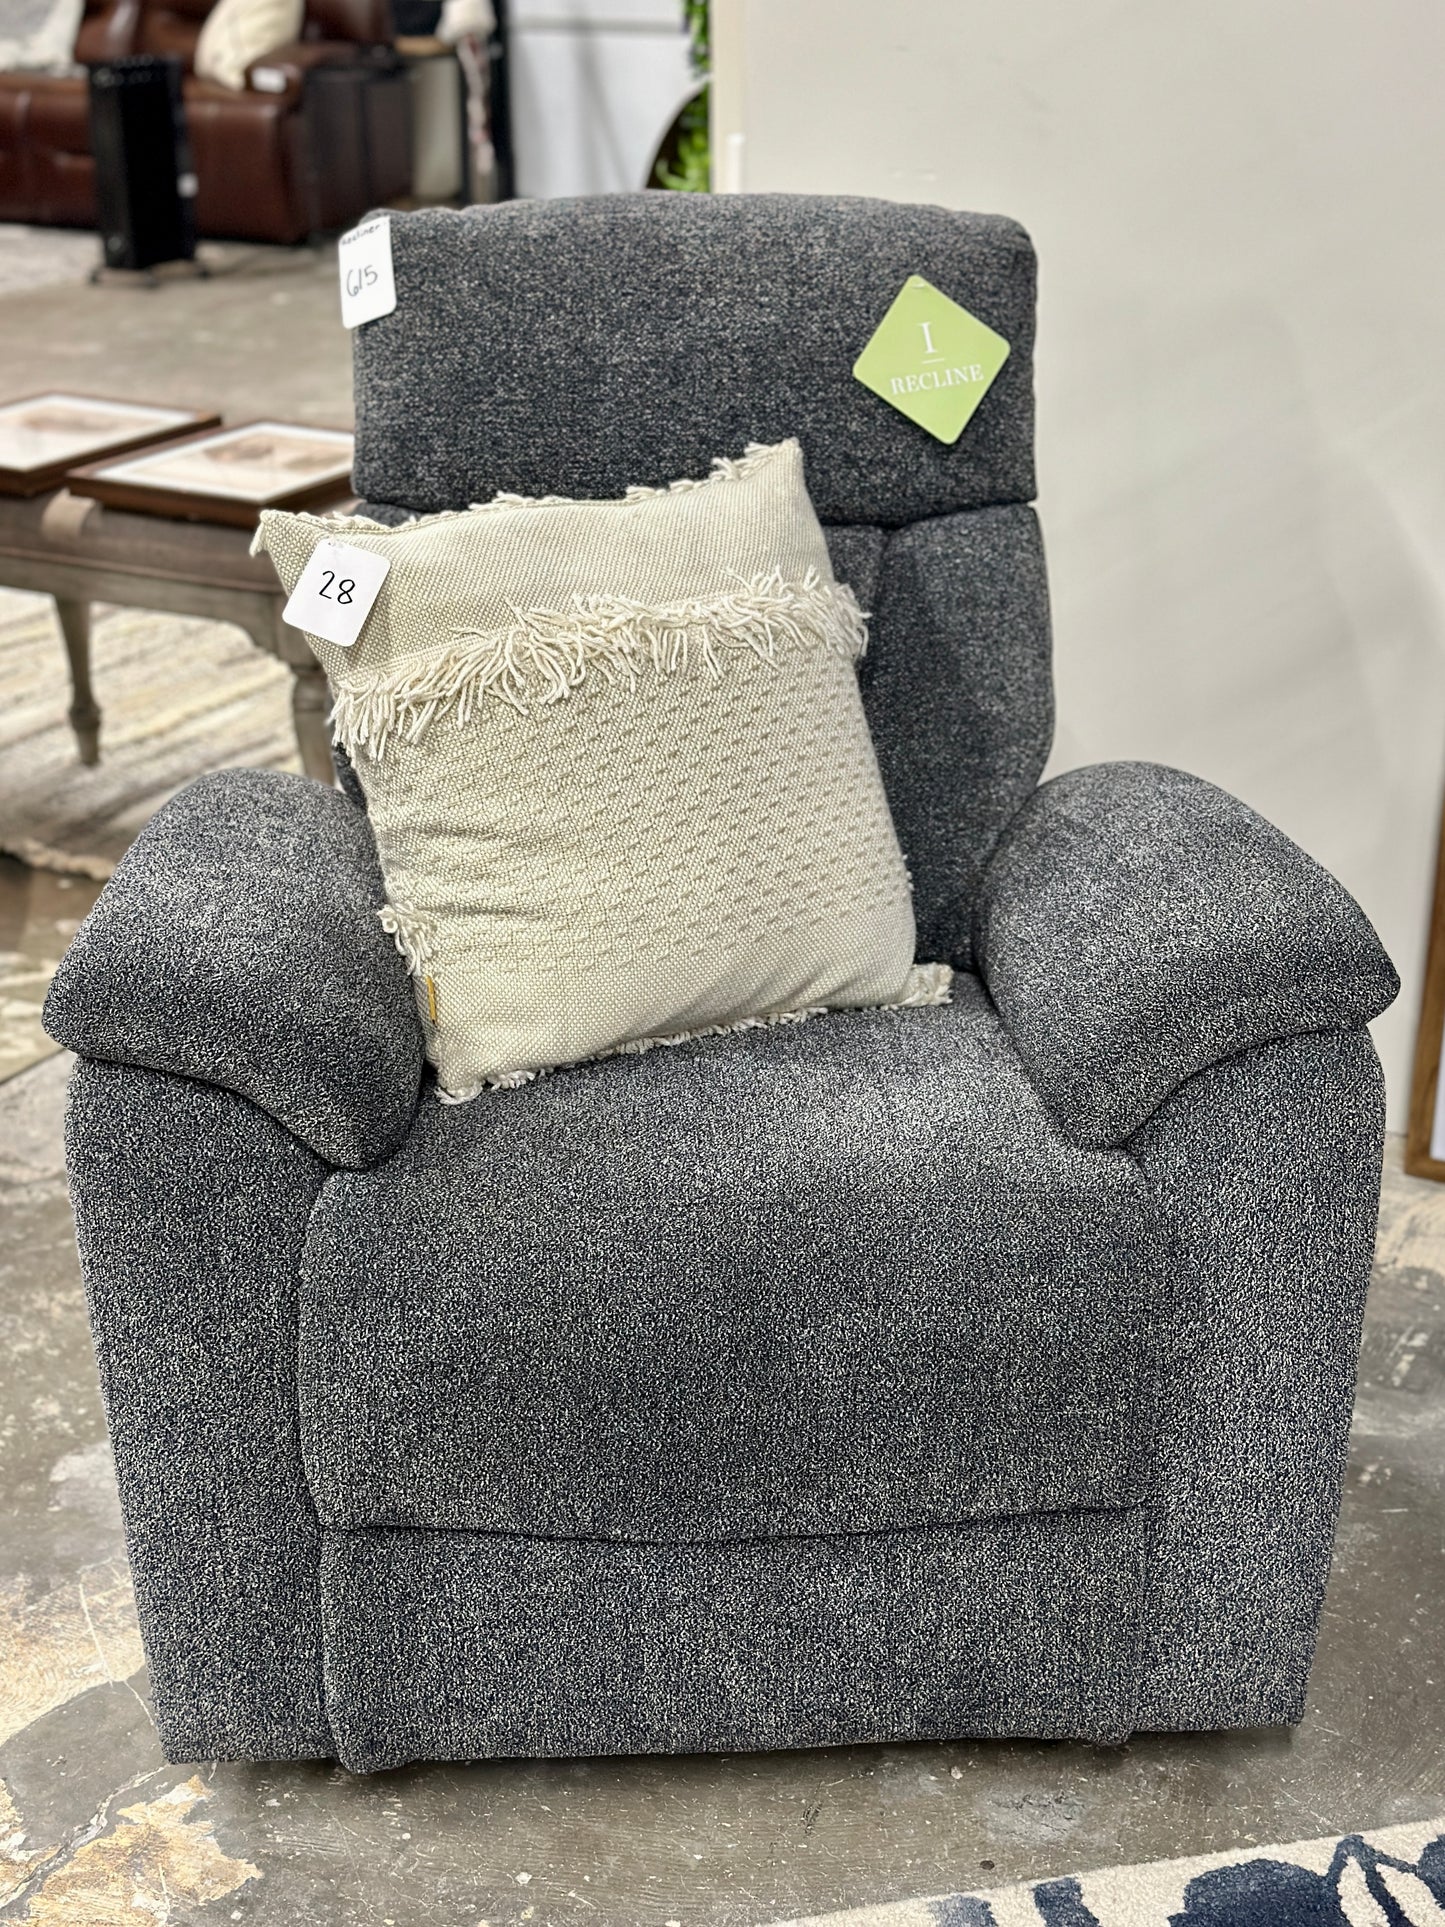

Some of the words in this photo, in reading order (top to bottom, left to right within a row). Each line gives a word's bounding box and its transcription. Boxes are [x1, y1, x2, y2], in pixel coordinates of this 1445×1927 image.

[346, 264, 378, 297] 615
[916, 321, 938, 355] I
[889, 363, 985, 396] RECLINE
[318, 570, 356, 605] 28
